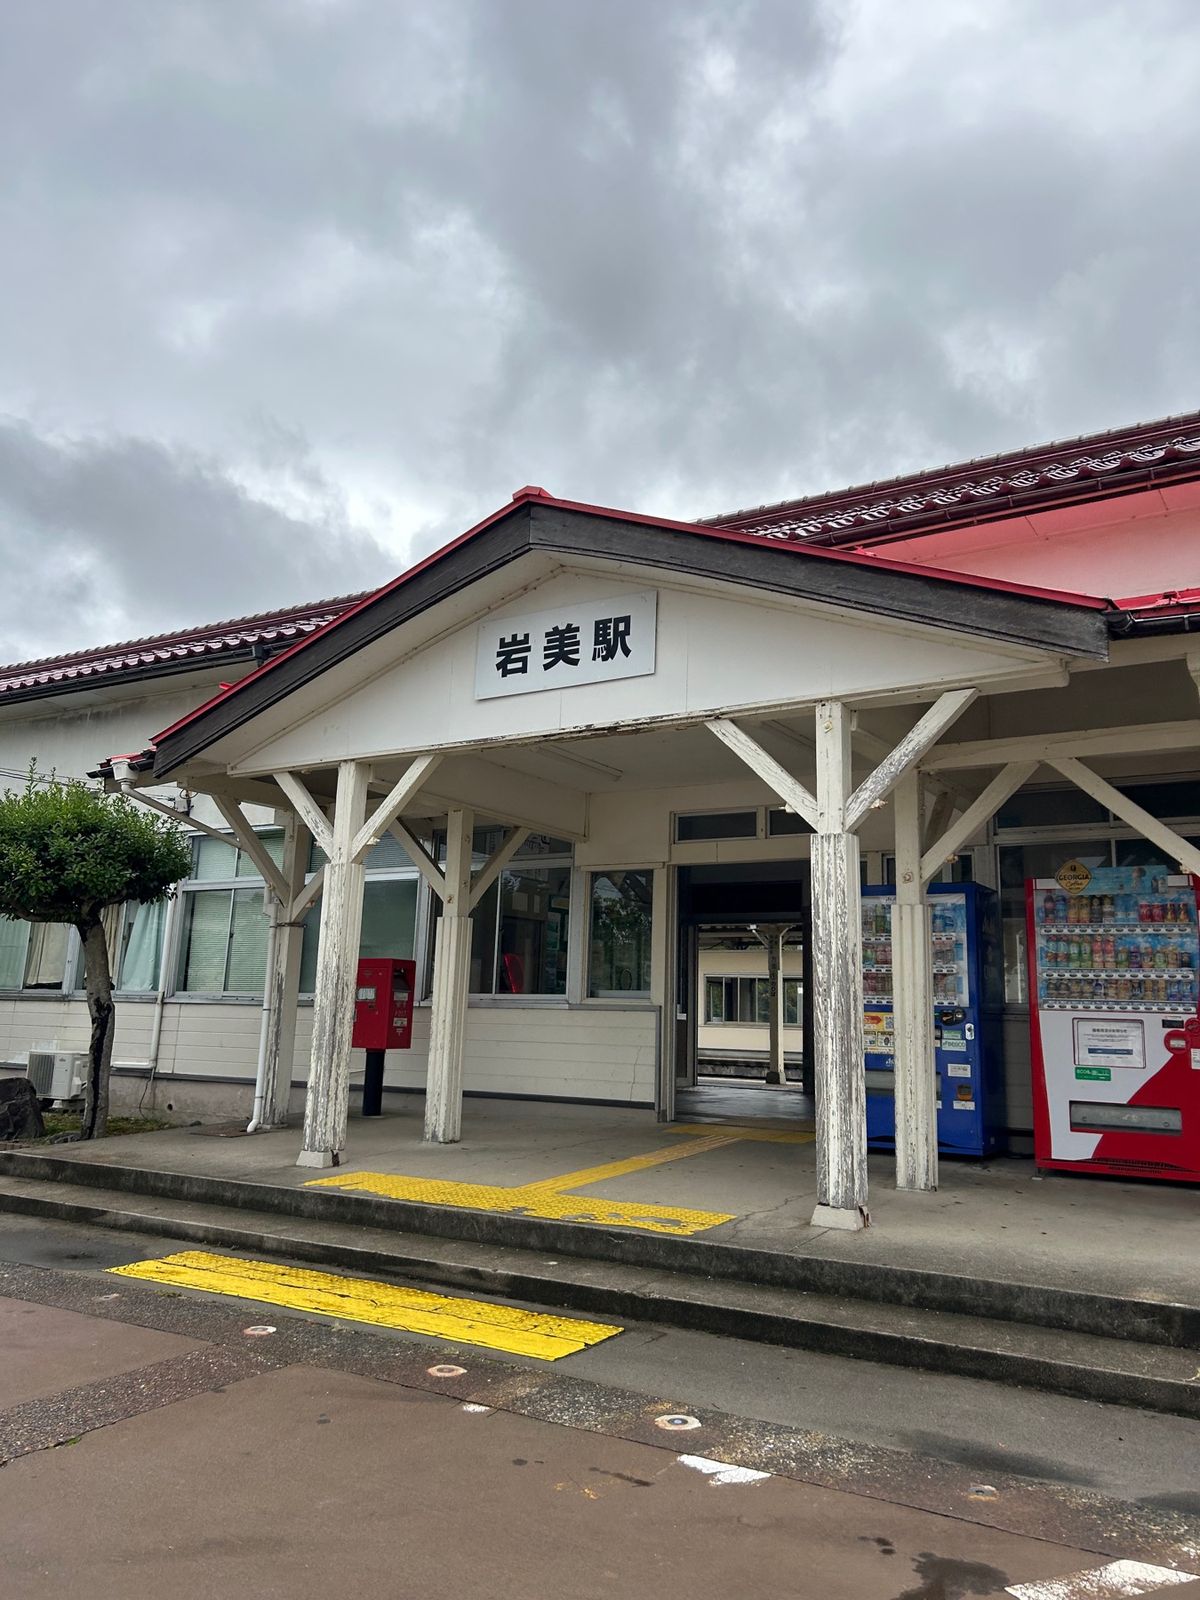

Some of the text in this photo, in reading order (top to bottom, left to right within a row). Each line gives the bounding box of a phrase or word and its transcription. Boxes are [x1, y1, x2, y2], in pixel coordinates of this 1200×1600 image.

[495, 614, 632, 678] 岩美駅
[1058, 873, 1090, 881] GEORGIA
